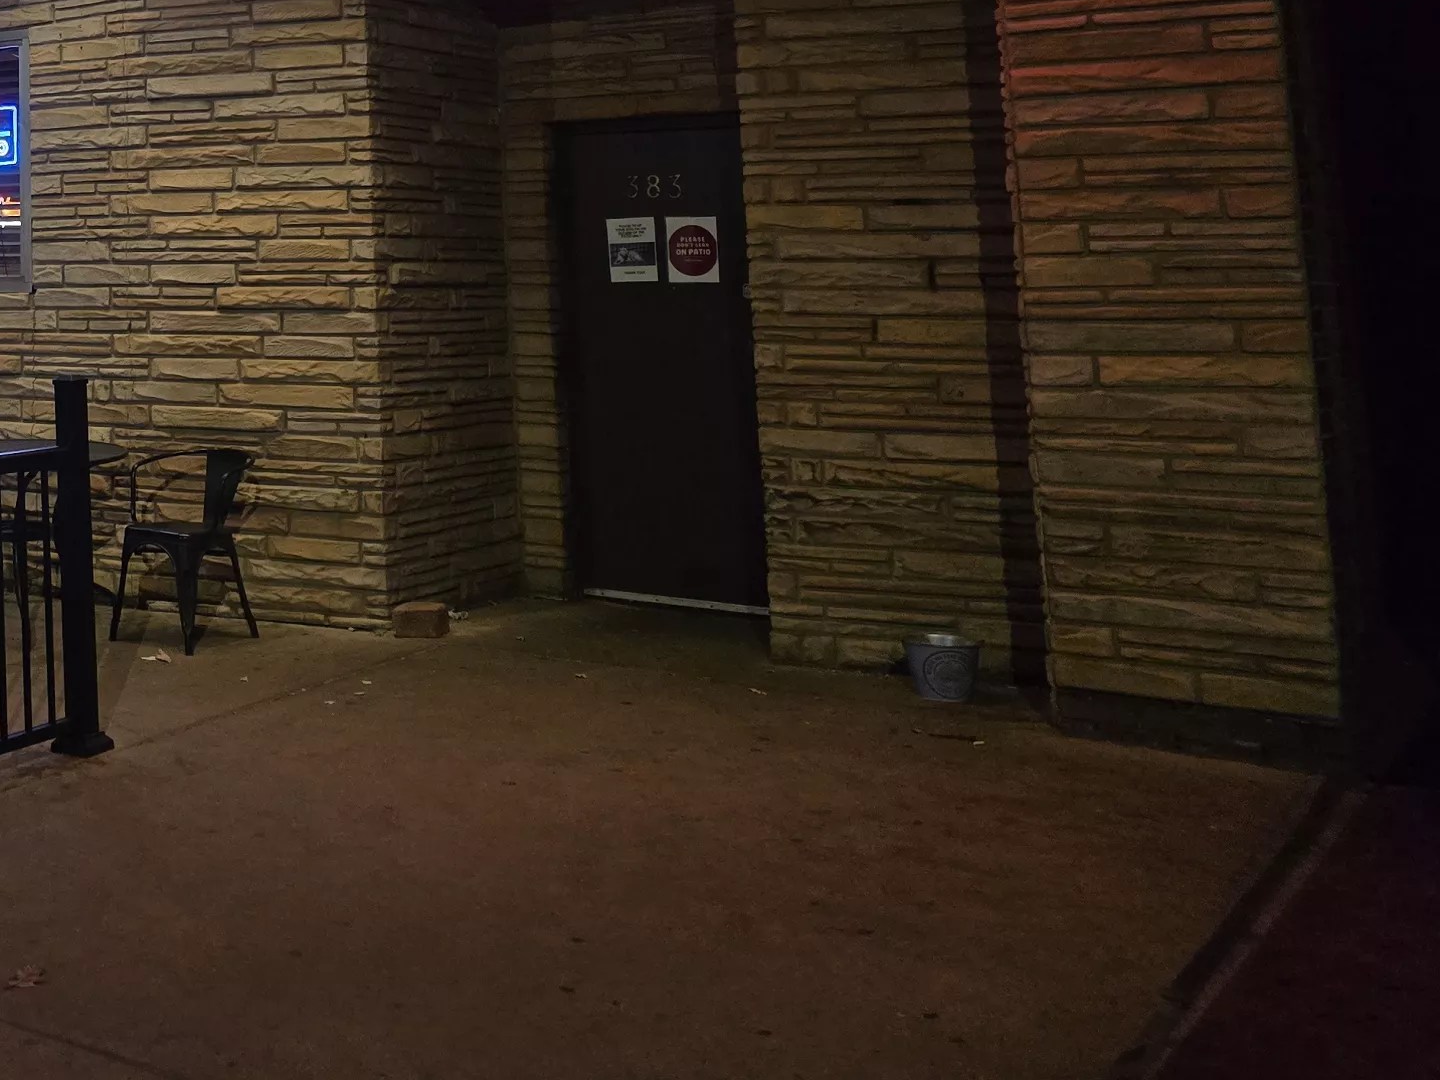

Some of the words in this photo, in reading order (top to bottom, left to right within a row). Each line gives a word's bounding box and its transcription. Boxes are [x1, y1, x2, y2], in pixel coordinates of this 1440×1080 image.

[627, 174, 682, 198] 383
[676, 248, 688, 256] ON
[688, 248, 711, 256] PATIO
